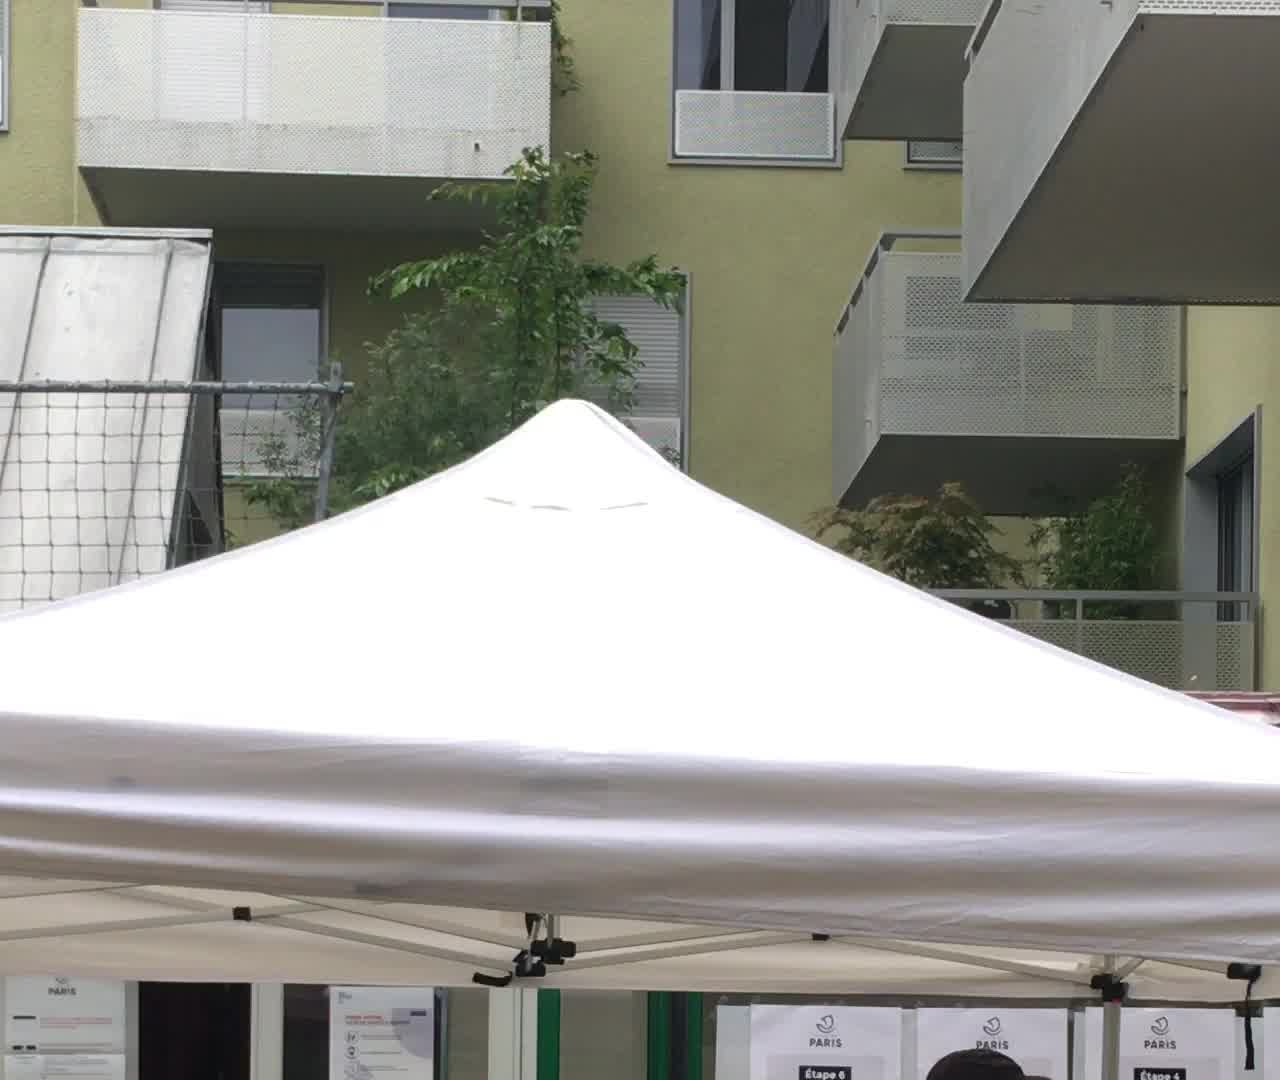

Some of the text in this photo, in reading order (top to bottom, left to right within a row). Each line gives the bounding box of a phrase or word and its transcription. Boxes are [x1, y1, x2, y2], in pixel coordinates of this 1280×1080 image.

[809, 1038, 843, 1048] PARIS
[976, 1040, 1009, 1050] PARIS
[1144, 1040, 1177, 1049] PARIS
[805, 1068, 836, 1080] Étape
[1173, 1072, 1180, 1080] 4
